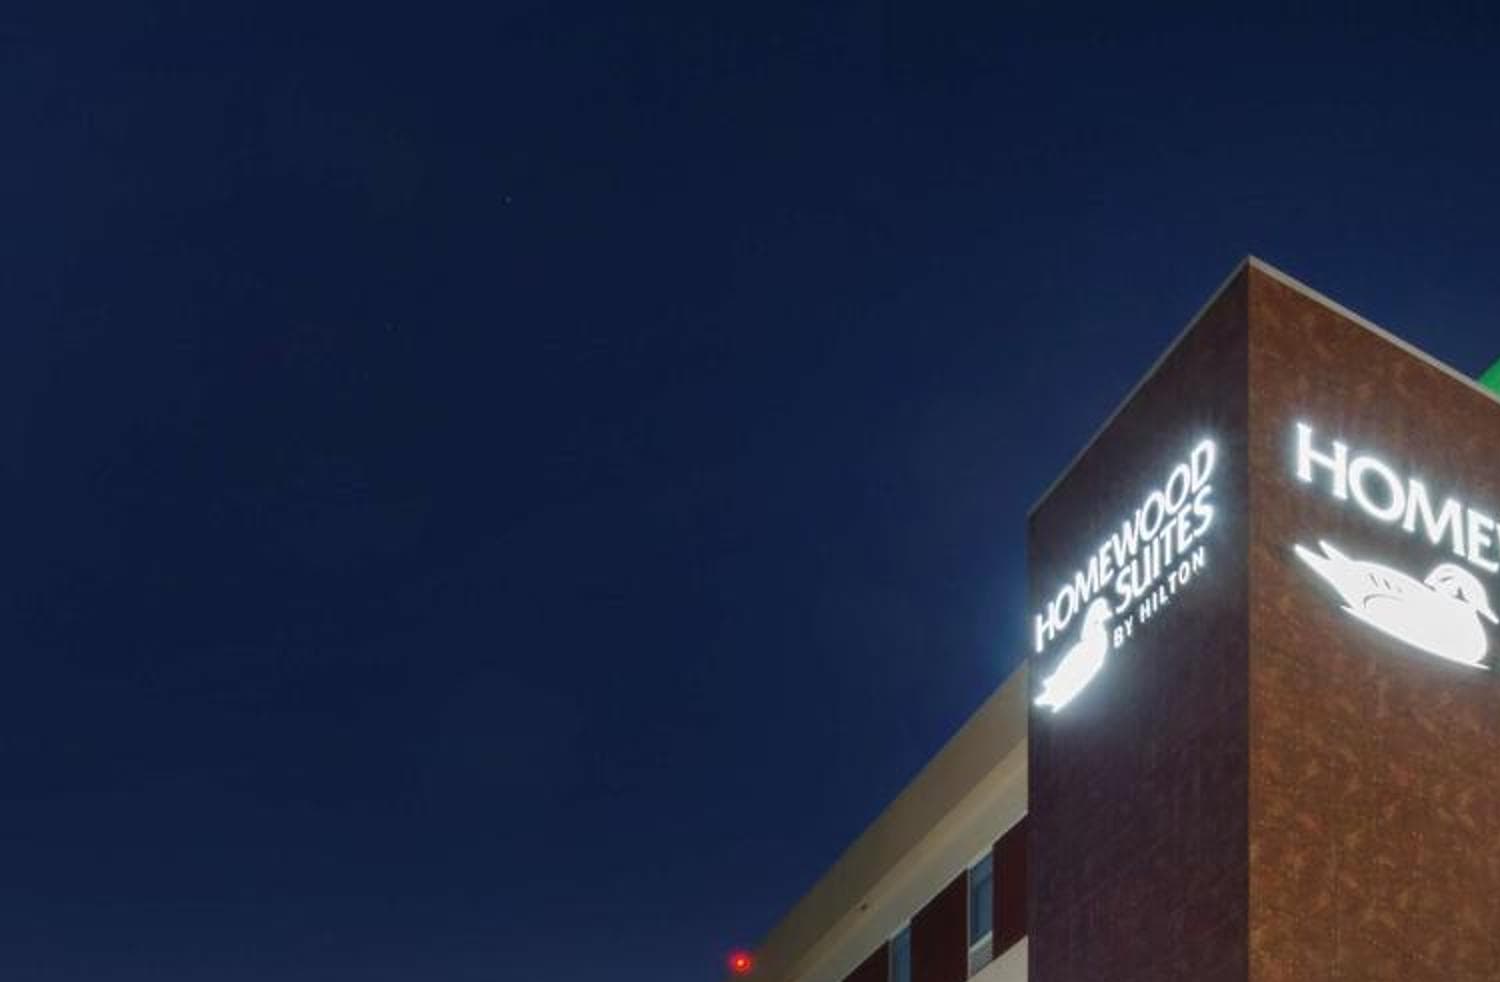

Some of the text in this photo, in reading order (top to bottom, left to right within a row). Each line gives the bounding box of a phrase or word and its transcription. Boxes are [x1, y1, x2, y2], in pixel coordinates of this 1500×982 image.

[1035, 439, 1216, 653] HOMEWOOD
[1113, 545, 1206, 648] BY HILTON
[1115, 485, 1214, 614] SUITES
